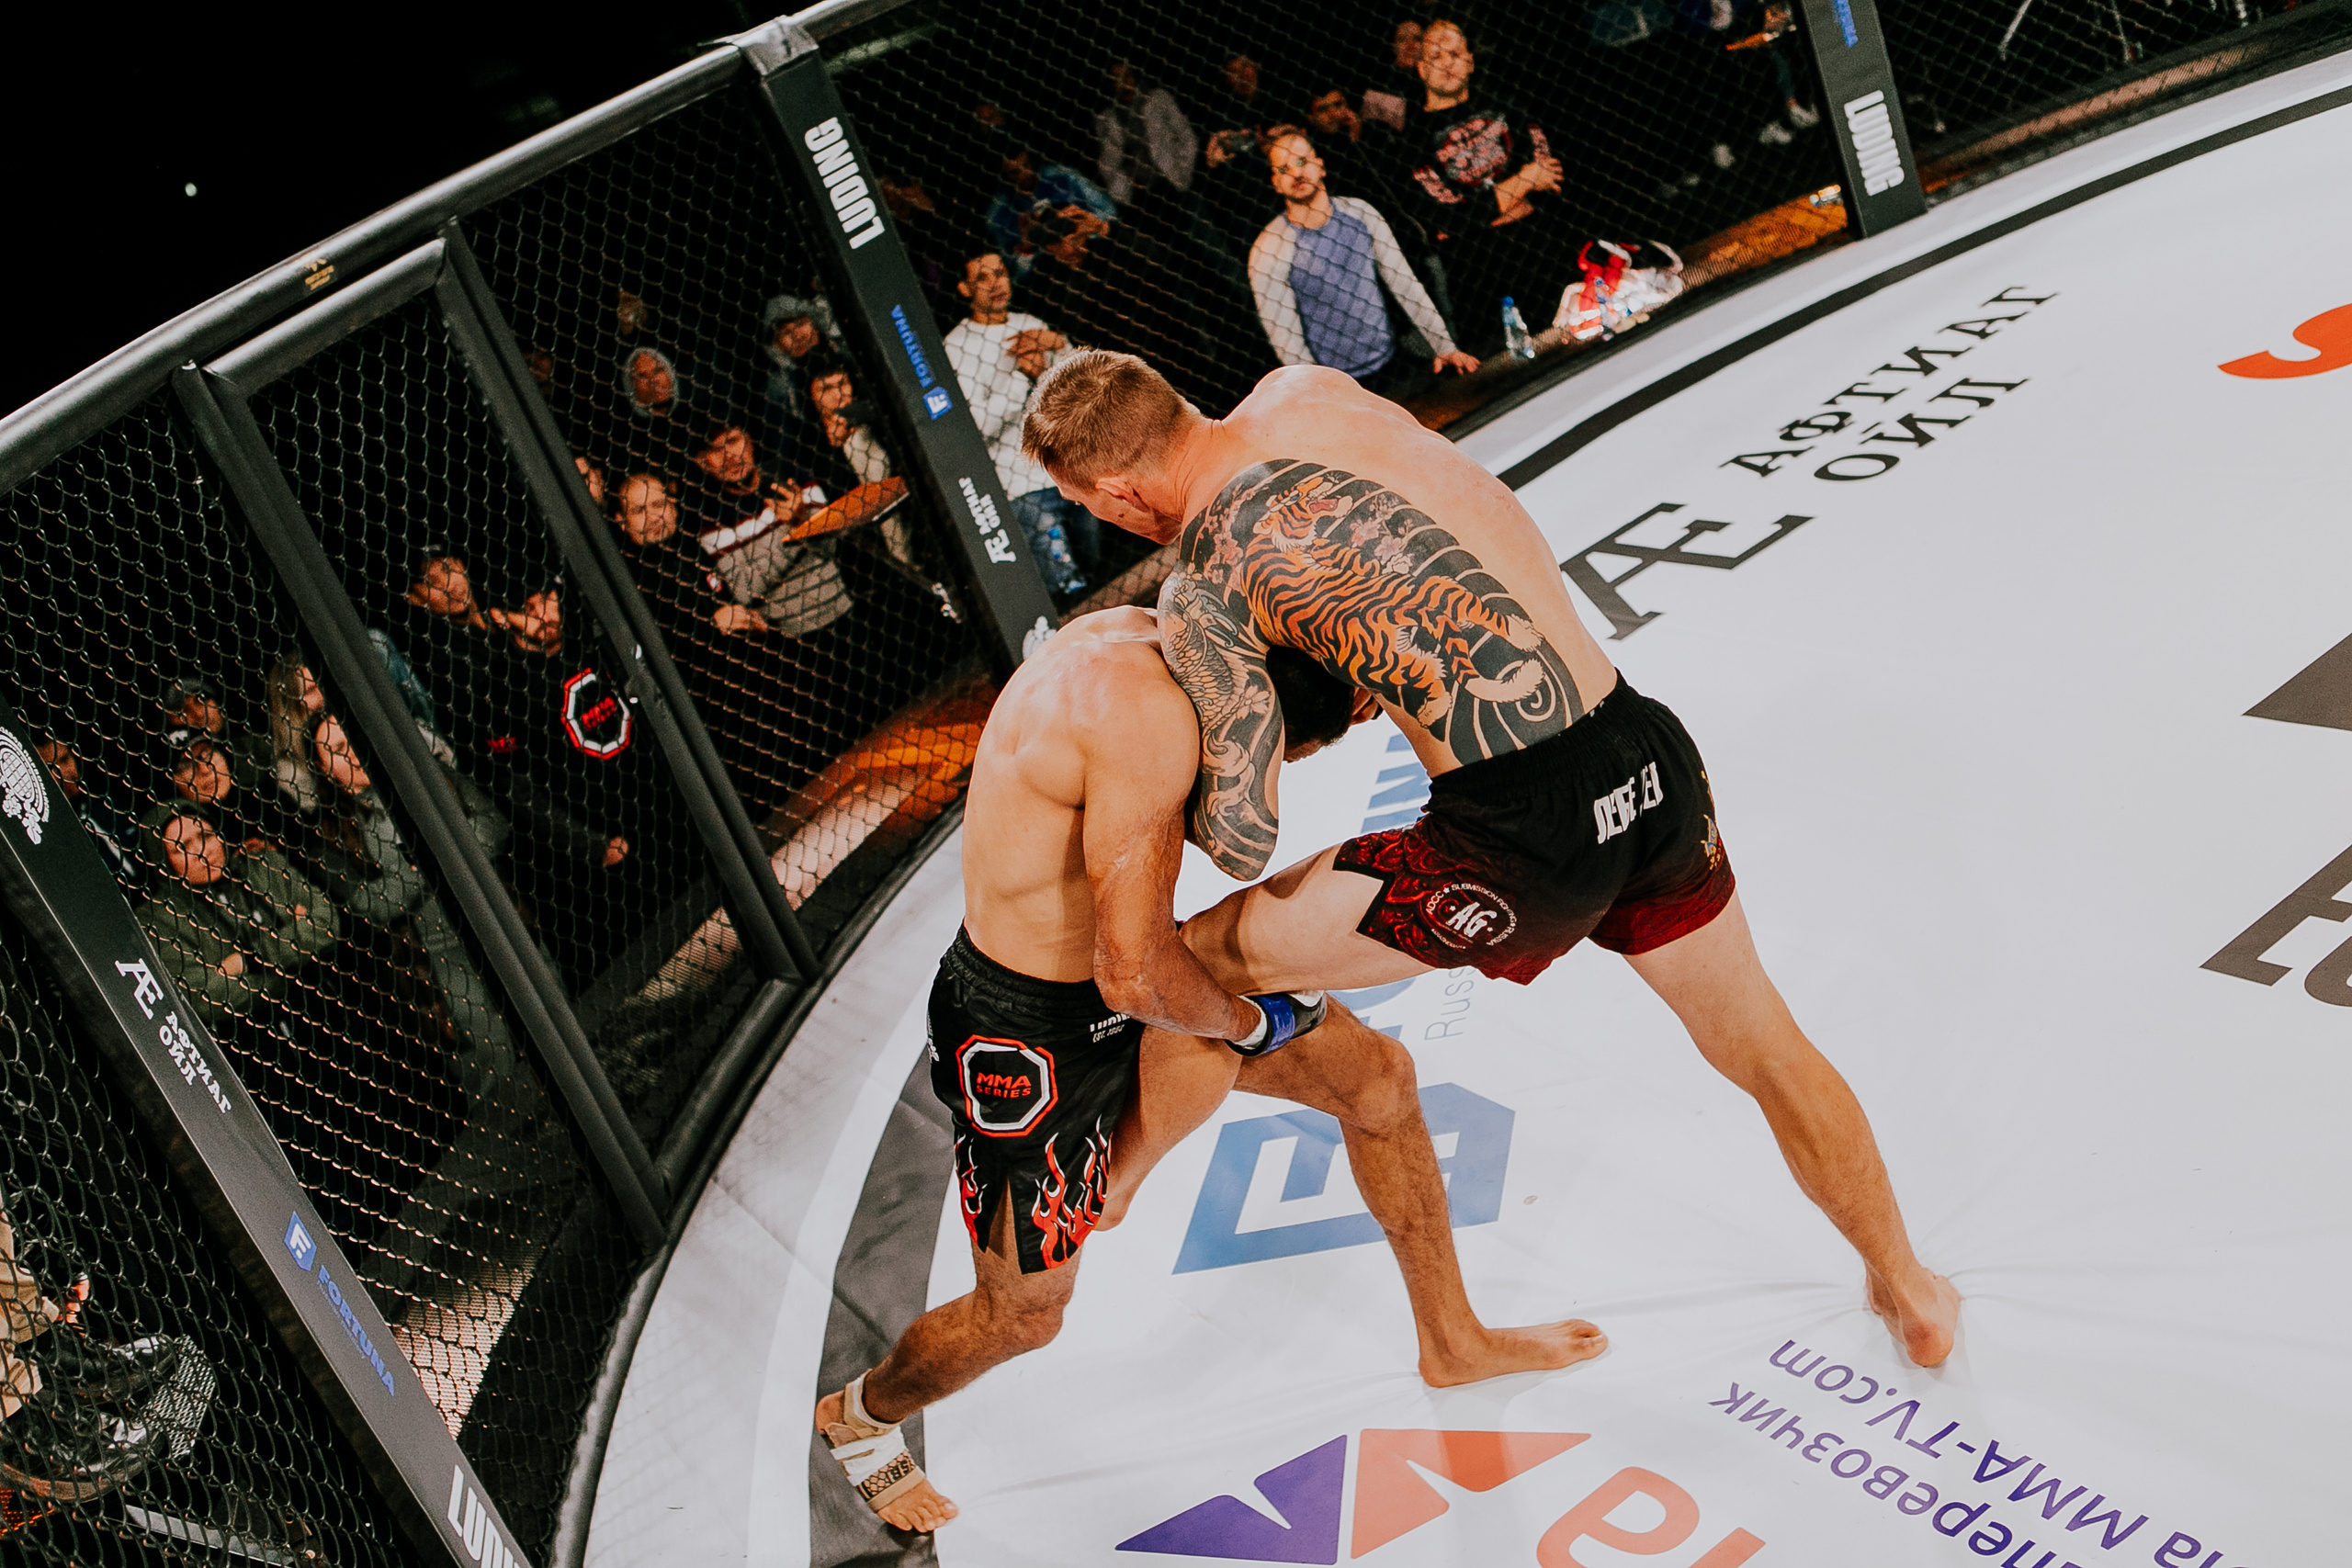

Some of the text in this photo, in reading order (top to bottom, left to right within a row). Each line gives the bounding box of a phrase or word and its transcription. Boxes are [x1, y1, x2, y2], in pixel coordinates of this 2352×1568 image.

[804, 117, 885, 250] LUDING
[1844, 90, 1905, 197] LUDING
[890, 304, 933, 389] FORTUNA
[1814, 378, 2031, 482] ОЙЛ
[1425, 889, 1443, 915] ADCC
[1450, 882, 1498, 900] SUBMISSION
[1424, 967, 1476, 1040] Russ
[159, 1027, 196, 1085] ОЙЛ
[976, 1071, 1032, 1089] MMA
[976, 1085, 1032, 1100] SERIES
[319, 1265, 395, 1397] FORTUNA
[1707, 1382, 2084, 1568] перевозчик
[1769, 1338, 2149, 1551] MMA-TV.com
[447, 1464, 522, 1568] LUD
